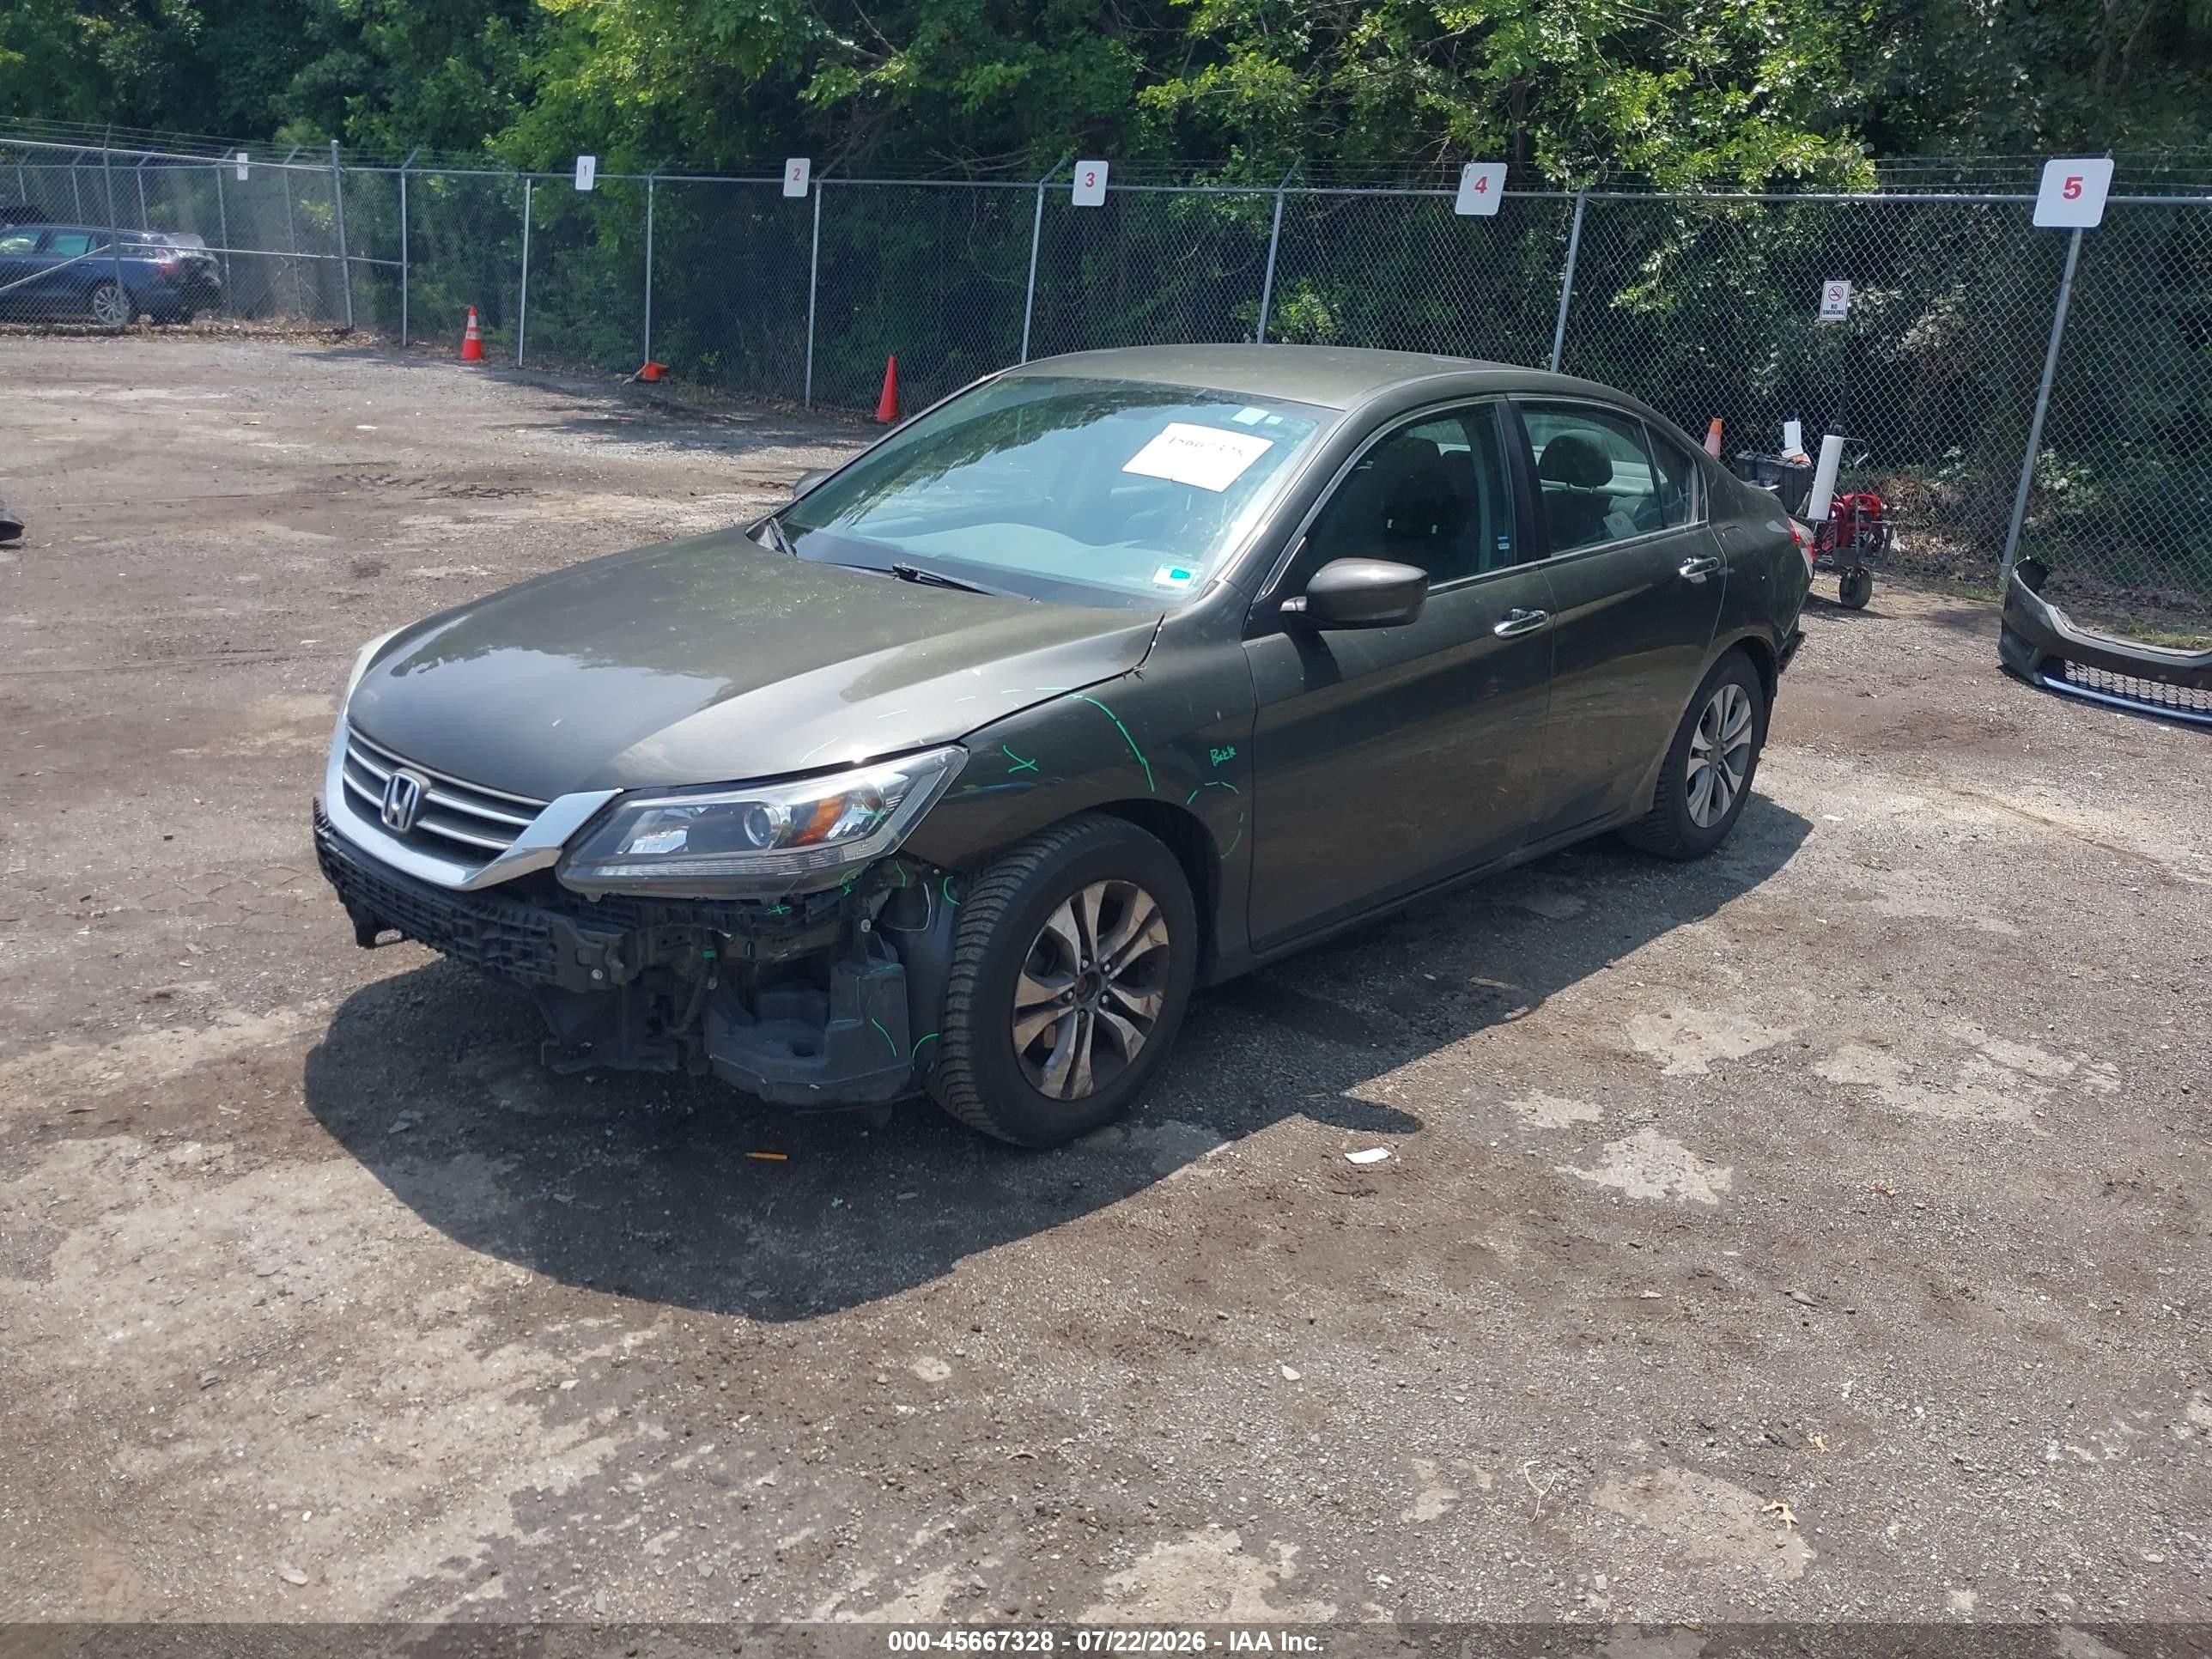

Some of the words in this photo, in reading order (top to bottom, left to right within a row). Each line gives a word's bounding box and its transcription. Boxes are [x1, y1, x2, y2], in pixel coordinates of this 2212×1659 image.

[793, 167, 801, 181] 2
[1085, 172, 1096, 187] 3
[1474, 177, 1488, 194] 4
[2063, 177, 2083, 199] 5
